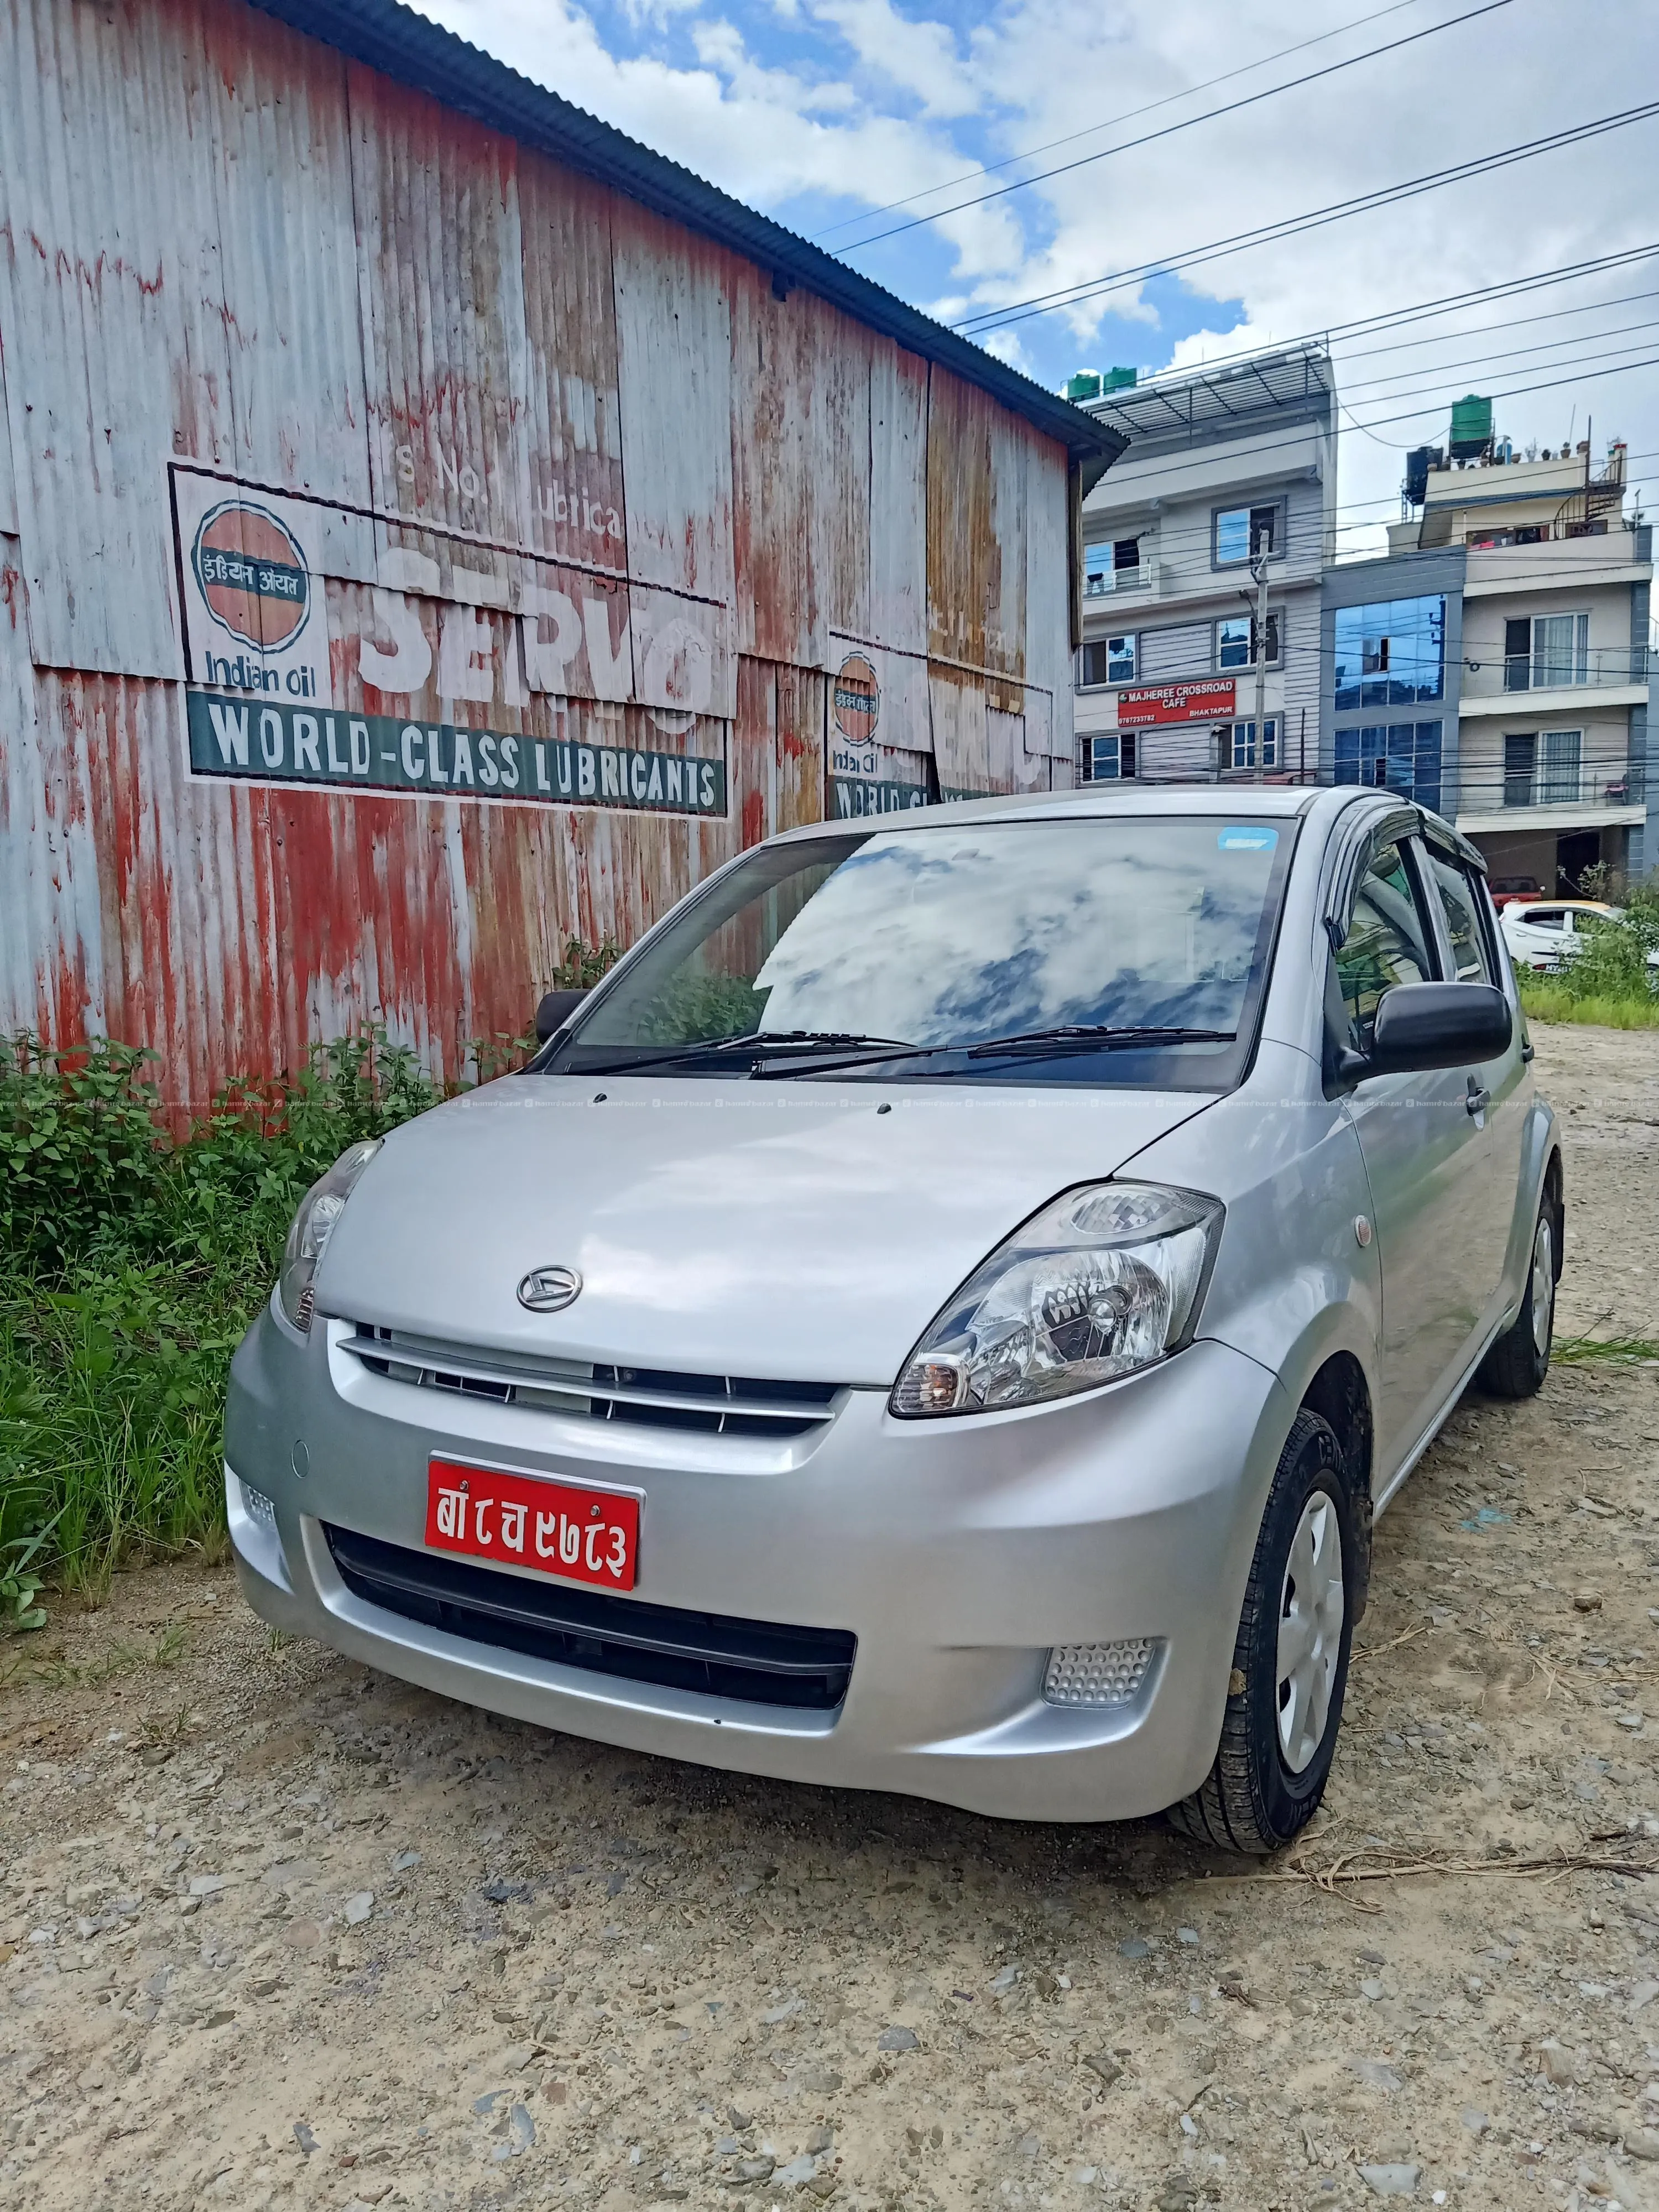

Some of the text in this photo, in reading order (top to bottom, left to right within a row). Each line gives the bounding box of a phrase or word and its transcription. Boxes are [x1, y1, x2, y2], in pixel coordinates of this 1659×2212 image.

[358, 546, 712, 734] SERVO
[205, 651, 279, 691] Indian
[1129, 681, 1233, 702] MAJHEREE CROSSROAD
[1162, 697, 1186, 709] CAFE
[1189, 706, 1233, 717] BHAKTAPUR
[535, 743, 715, 807] LUBRICANTS
[475, 1499, 494, 1545] ८
[501, 1501, 528, 1553] च
